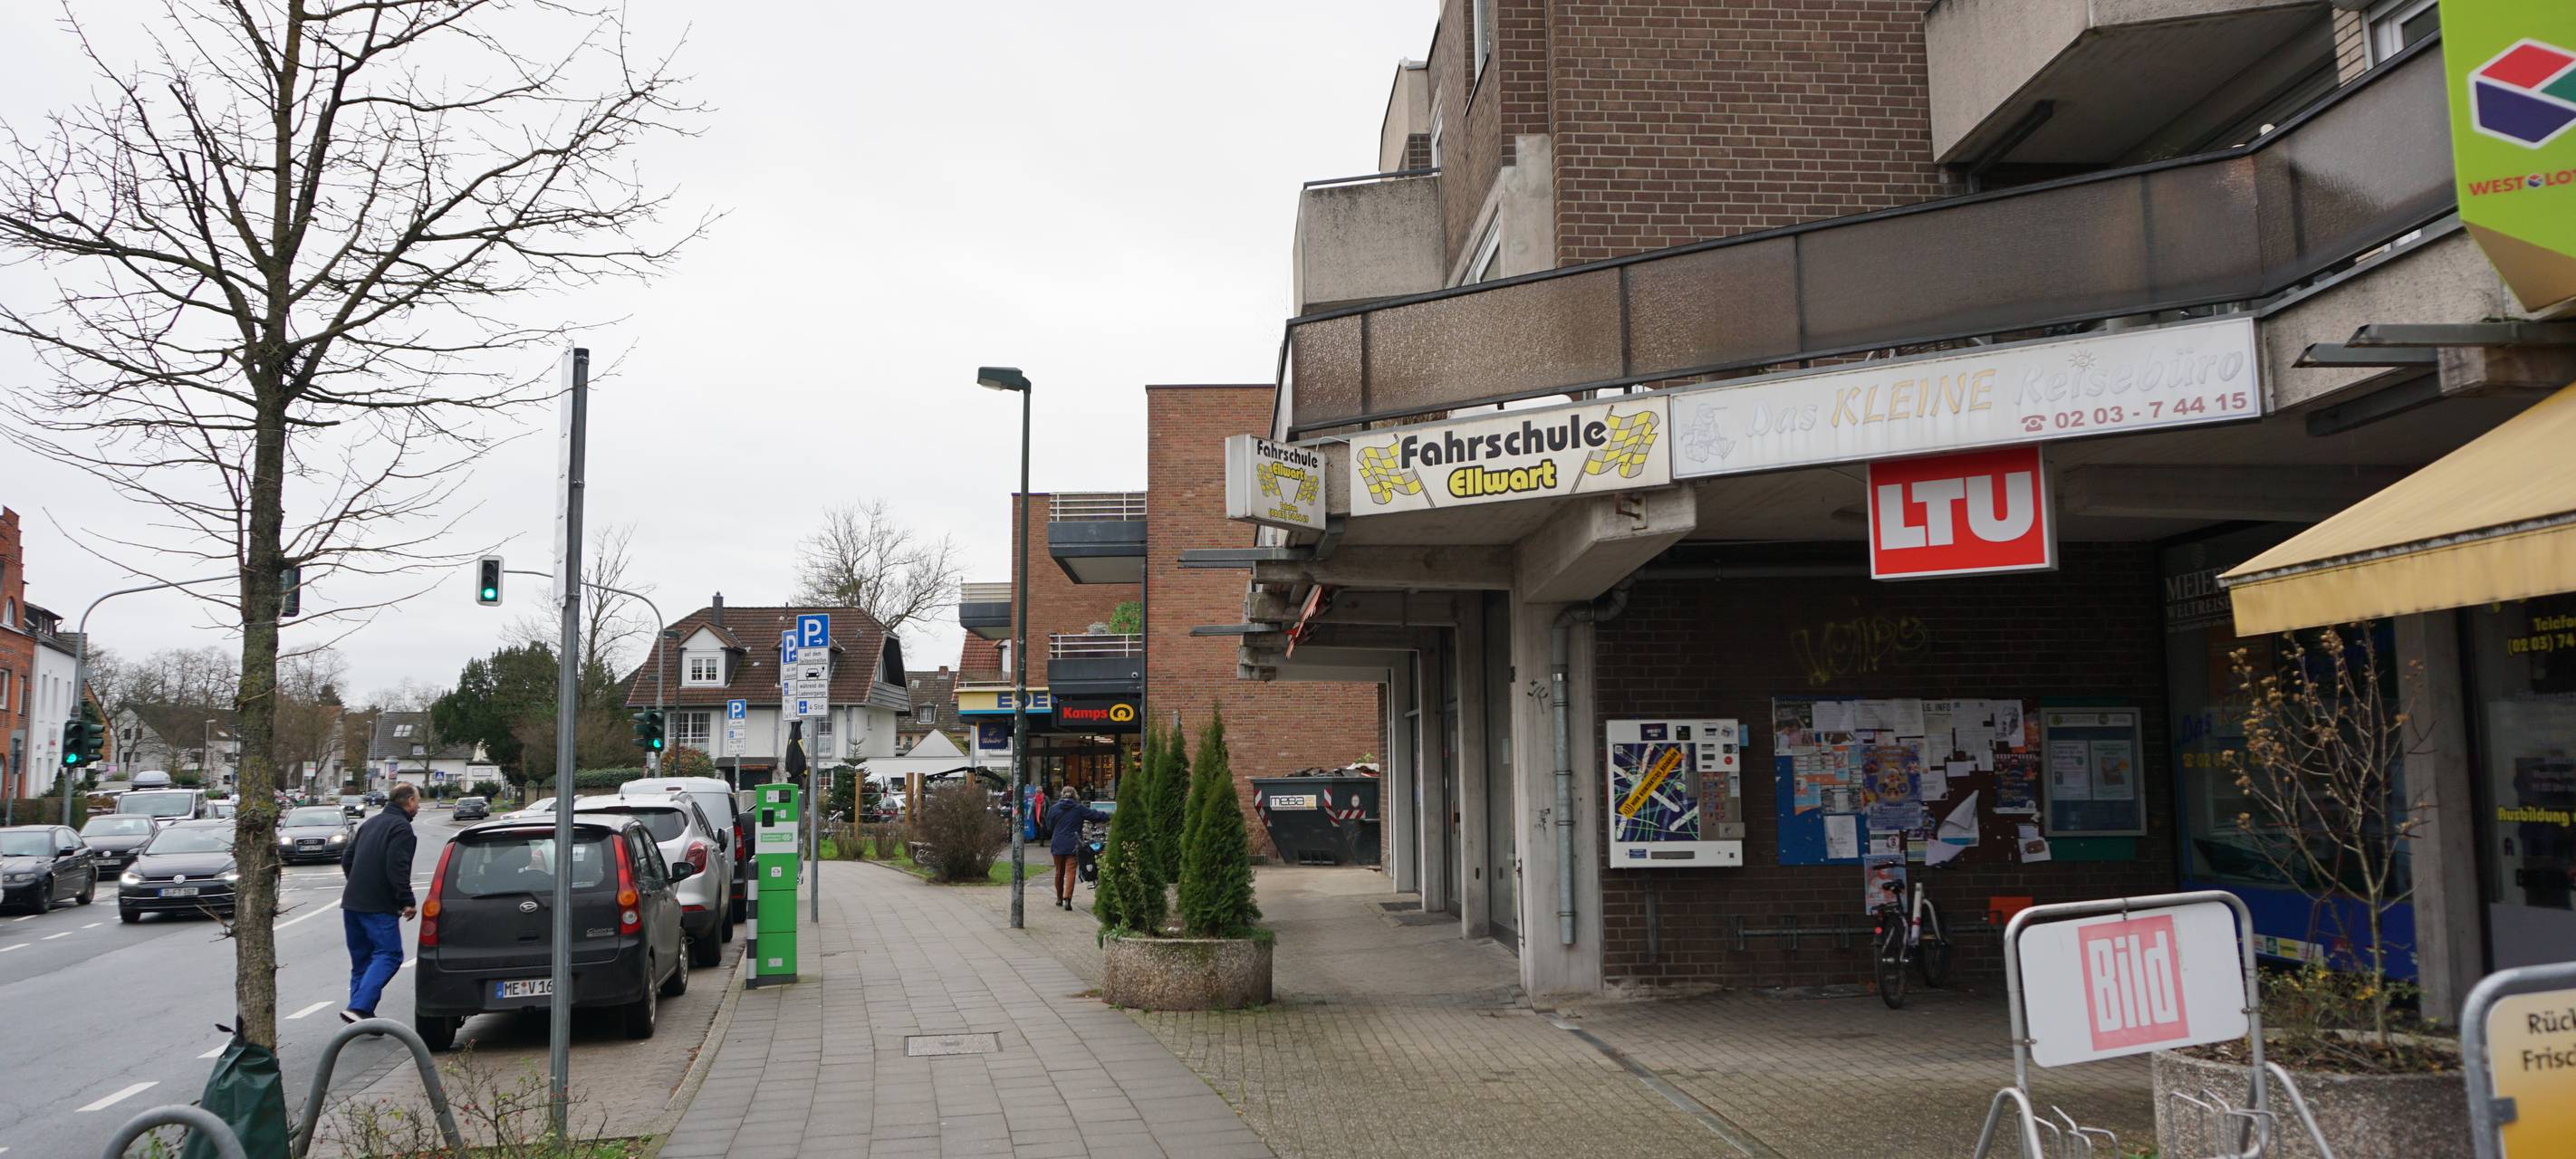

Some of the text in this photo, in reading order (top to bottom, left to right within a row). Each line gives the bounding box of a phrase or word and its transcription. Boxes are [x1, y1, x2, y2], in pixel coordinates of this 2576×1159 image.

[2468, 169, 2576, 196] WEST LO
[1746, 347, 2244, 437] Das KLEINE Reisebüro
[2054, 411, 2085, 429] 02
[2093, 406, 2124, 424] 03
[2148, 401, 2164, 418] 7
[2173, 396, 2206, 416] 44
[2216, 391, 2247, 410] 15
[1257, 439, 1318, 468] Fahrschule
[1401, 414, 1608, 469] Fahrschule
[1271, 461, 1305, 481] Ellwart
[1447, 458, 1557, 498] Ellwart
[1877, 471, 2034, 551] LTU
[803, 618, 822, 647] P
[1062, 706, 1108, 721] Kamps
[2496, 805, 2571, 828] Ausbildung
[505, 982, 520, 996] ME
[528, 982, 536, 994] V
[2087, 930, 2180, 1032] Bild
